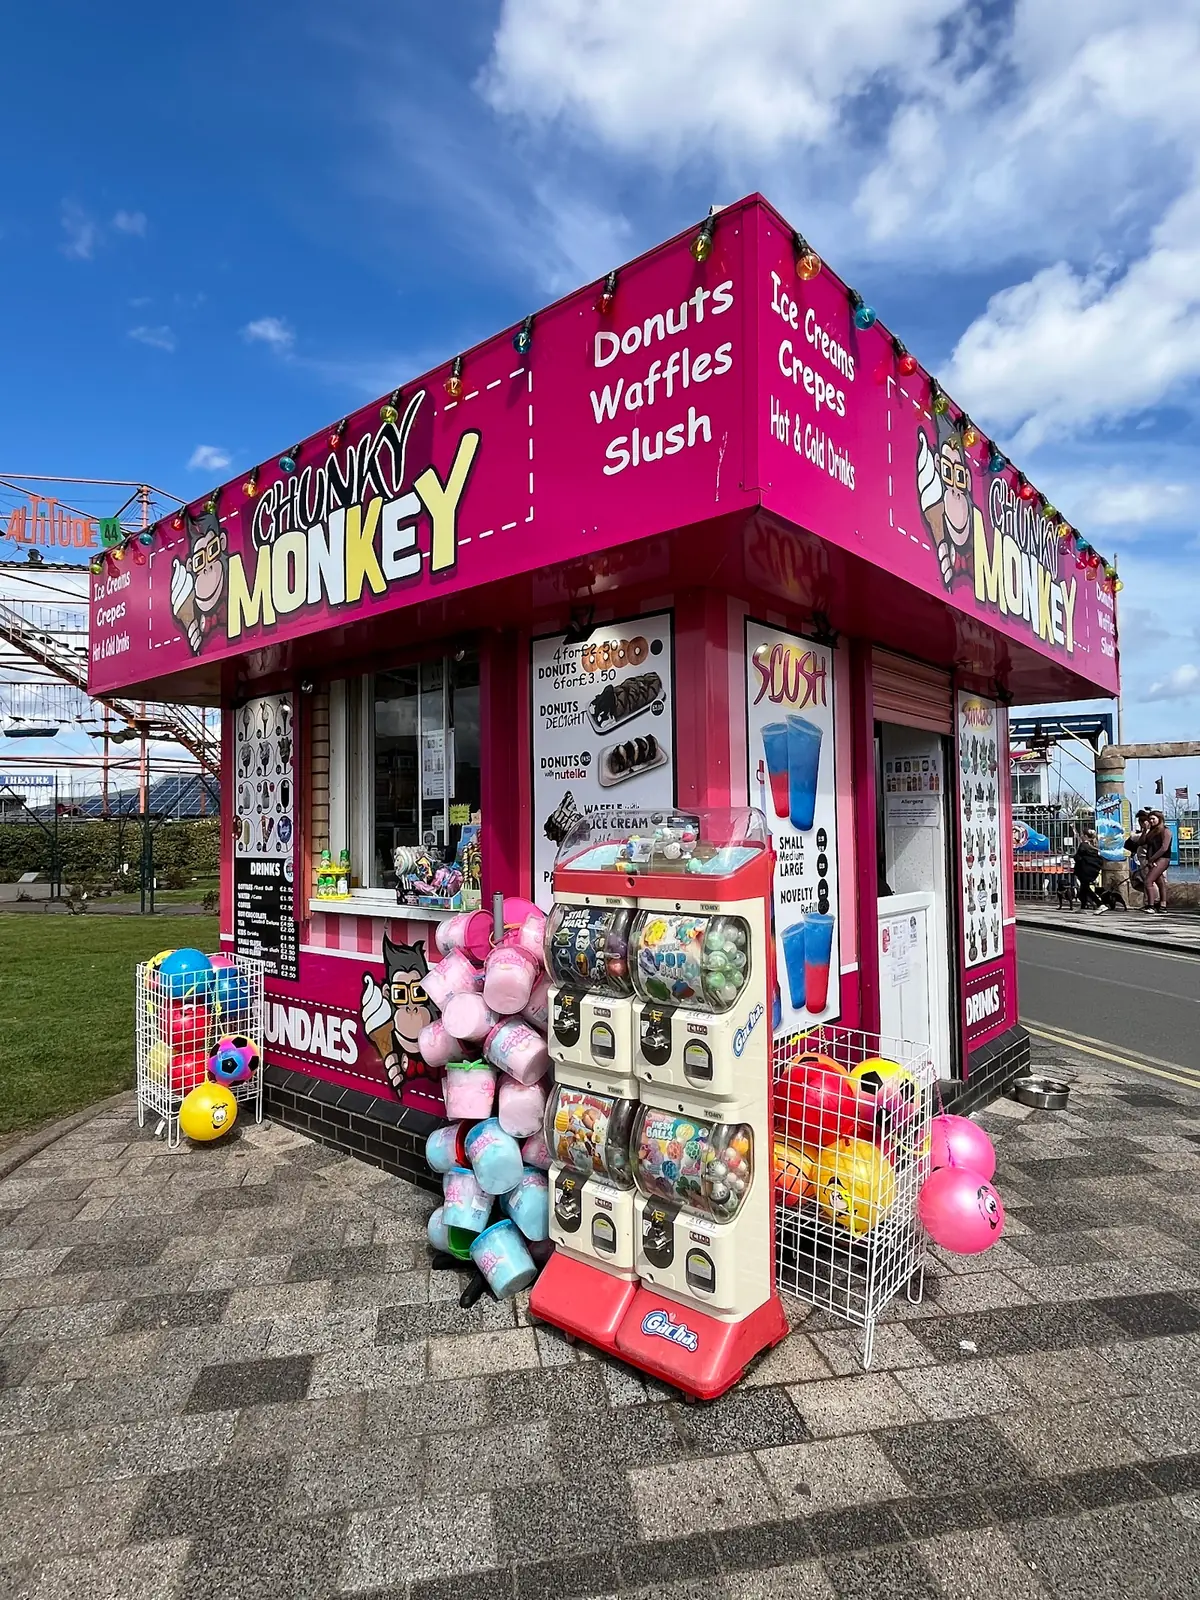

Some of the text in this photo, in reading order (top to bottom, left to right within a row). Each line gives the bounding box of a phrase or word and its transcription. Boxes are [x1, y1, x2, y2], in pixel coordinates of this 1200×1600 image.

[594, 280, 734, 368] Donuts
[770, 270, 855, 382] Ice Creams
[589, 342, 733, 424] Waffles
[778, 339, 846, 417] Crepes
[603, 406, 712, 476] Slush
[770, 394, 855, 491] Hot & Cold Drinks
[252, 389, 426, 549] CHUNKY
[104, 523, 119, 541] 44
[227, 431, 480, 640] MONKEY
[988, 477, 1061, 581] CHUNKY
[94, 571, 130, 602] Ice Creams
[973, 506, 1077, 653] MONKEY
[96, 601, 126, 627] Crepes
[539, 662, 576, 679] DONUTS
[540, 701, 578, 716] DONUTS
[541, 755, 579, 768] DONUTS
[4, 776, 49, 785] THEATRE
[555, 768, 586, 780] nutella
[611, 818, 648, 829] CREAM
[779, 836, 804, 850] SMALL
[779, 850, 804, 861] Medium
[250, 862, 281, 876] DRINKS
[780, 862, 804, 877] LARGE
[780, 887, 813, 904] NOVELTY
[565, 909, 590, 920] STAR
[801, 902, 818, 914] Refill
[561, 919, 590, 928] WARS
[655, 952, 687, 968] POP
[966, 984, 1000, 1027] DRINKS
[704, 1110, 723, 1119] TOMY
[646, 1126, 674, 1140] BALLS
[652, 1121, 674, 1131] MESH
